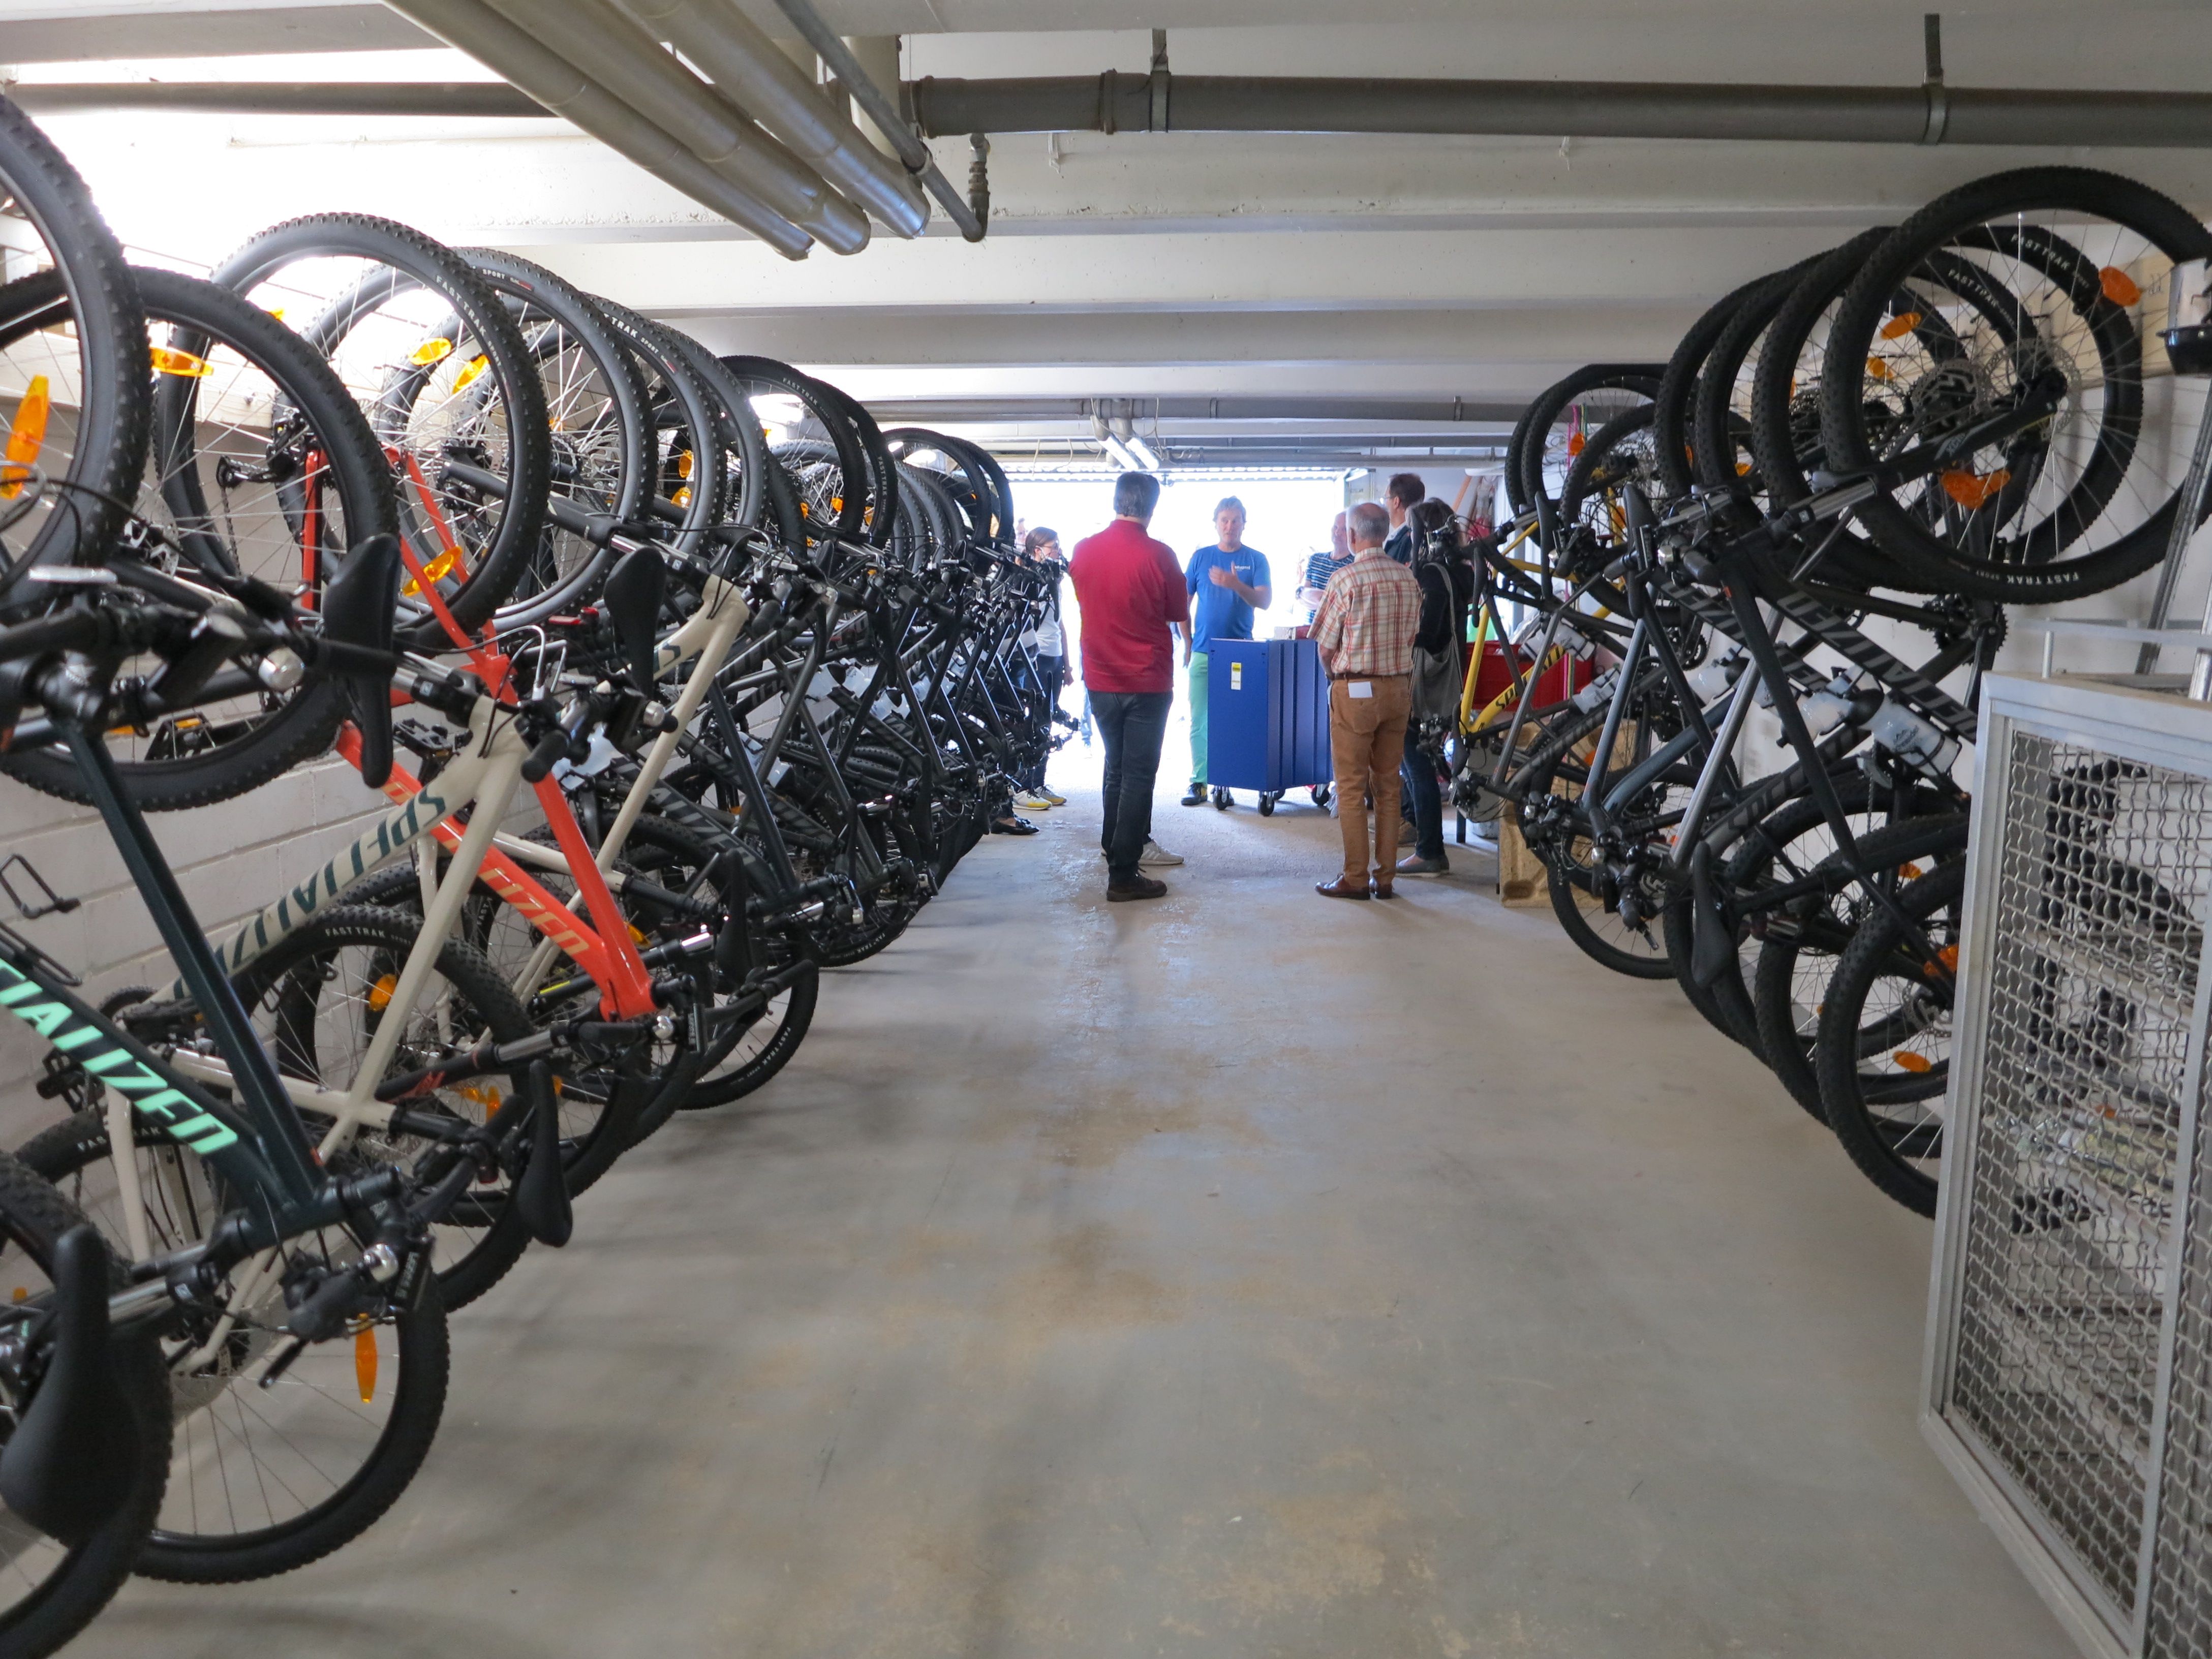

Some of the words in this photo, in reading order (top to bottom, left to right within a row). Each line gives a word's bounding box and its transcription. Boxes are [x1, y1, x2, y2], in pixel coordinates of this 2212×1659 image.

[482, 268, 506, 280] SPORT
[436, 275, 462, 302] FAST
[463, 301, 486, 337] TRAK
[611, 317, 638, 339] TRAK
[640, 337, 659, 354] SPORT
[2007, 575, 2042, 585] TRAK
[2046, 572, 2079, 585] FAST
[173, 786, 446, 1000] SPECIALIZ
[325, 927, 352, 936] FAST
[355, 927, 386, 938] TRAK
[0, 958, 238, 1154] IALIZED
[77, 1135, 107, 1151] FAS
